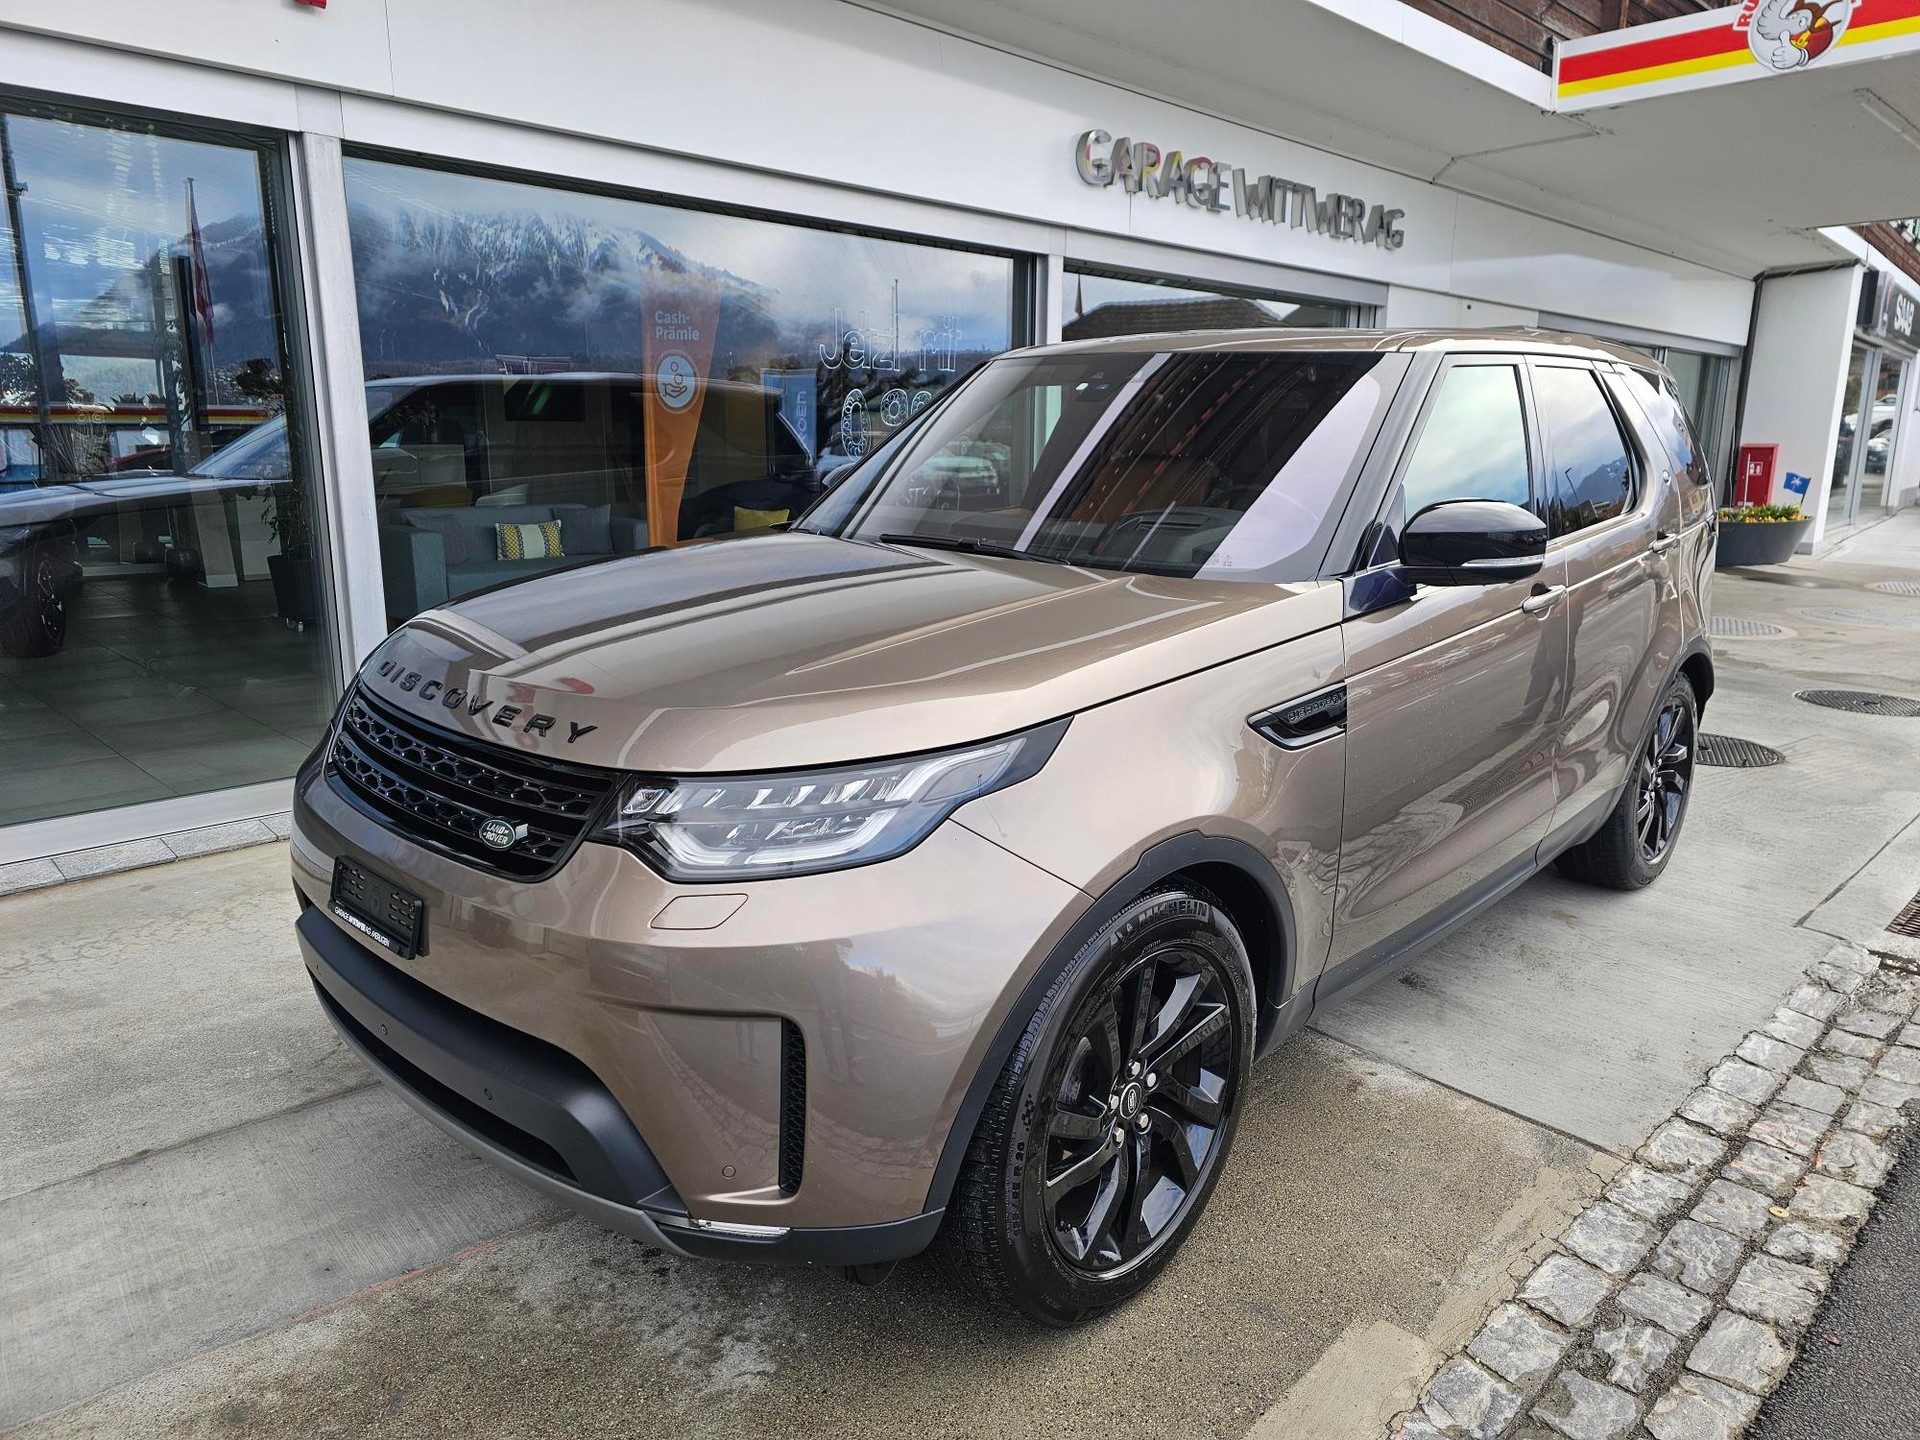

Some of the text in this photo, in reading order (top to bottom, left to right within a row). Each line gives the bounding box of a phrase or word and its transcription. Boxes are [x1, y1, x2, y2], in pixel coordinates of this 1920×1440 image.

[1076, 129, 1231, 212] GARAGE
[1364, 204, 1405, 250] AG
[655, 310, 690, 324] Cash-
[655, 326, 700, 340] Prämie
[819, 308, 900, 372] Jetzt
[376, 660, 598, 744] DISCOVERY
[485, 831, 509, 845] ROVER
[486, 822, 506, 835] LAND
[1138, 899, 1209, 927] MICHELIN
